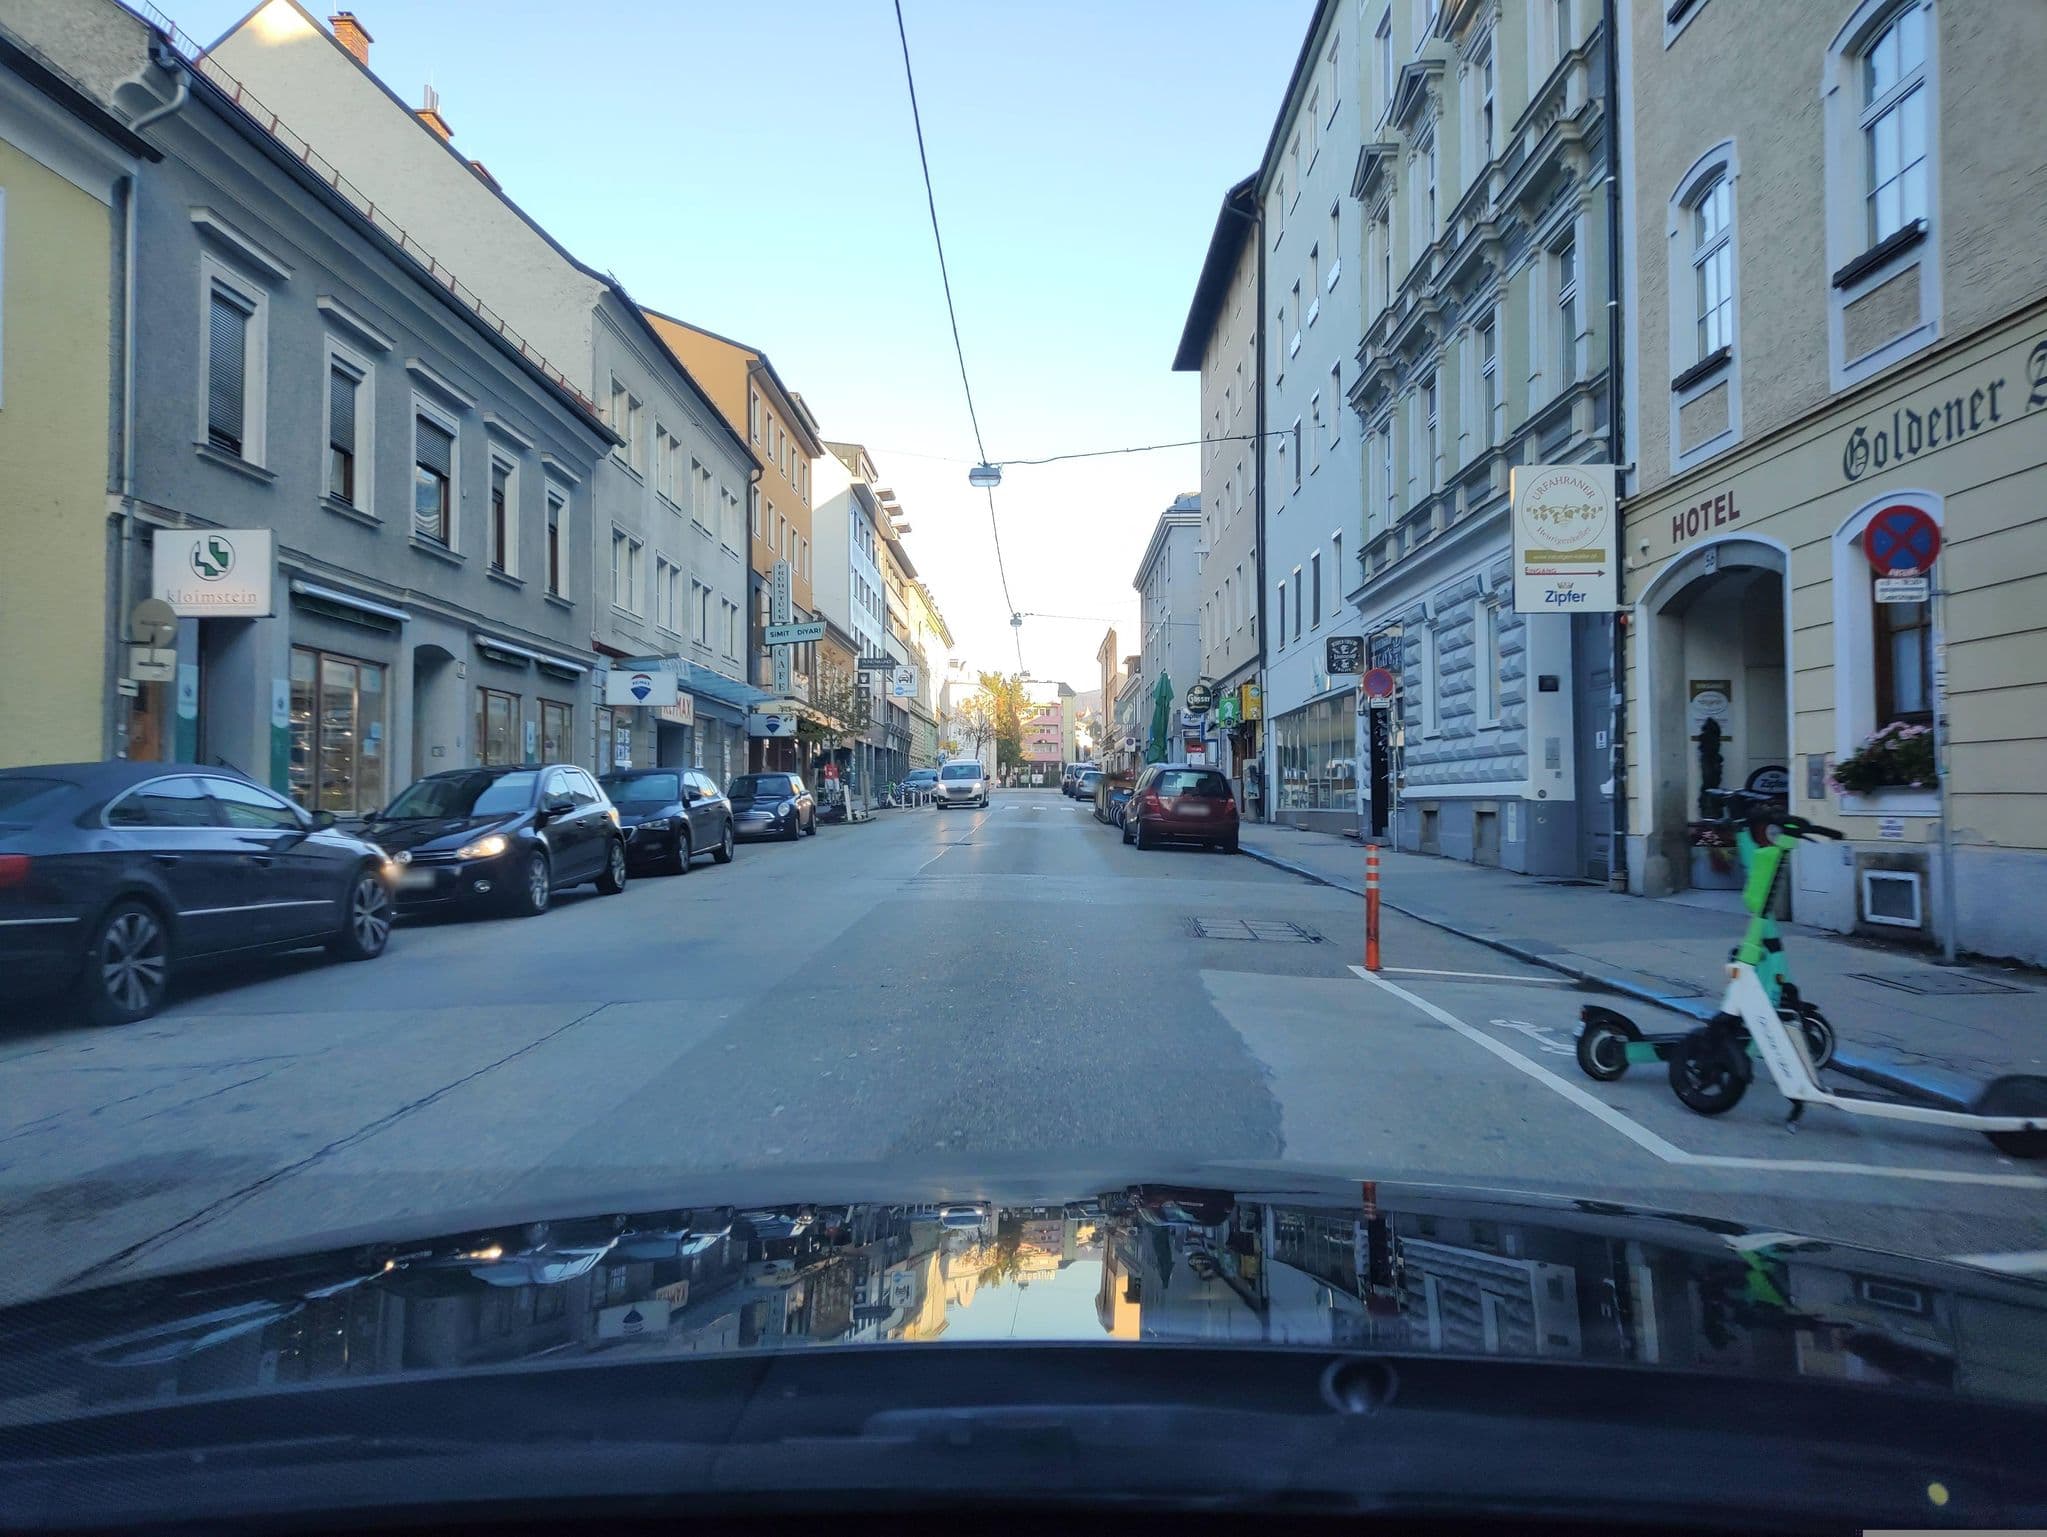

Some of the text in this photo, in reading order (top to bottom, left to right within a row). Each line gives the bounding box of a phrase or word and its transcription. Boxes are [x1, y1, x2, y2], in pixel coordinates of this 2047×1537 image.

[1843, 376, 2005, 481] Goldener
[1532, 475, 1596, 501] URFAHRANER
[1672, 490, 1740, 544] HOTEL
[167, 589, 257, 603] kloimstein
[1545, 590, 1587, 606] Zipfer
